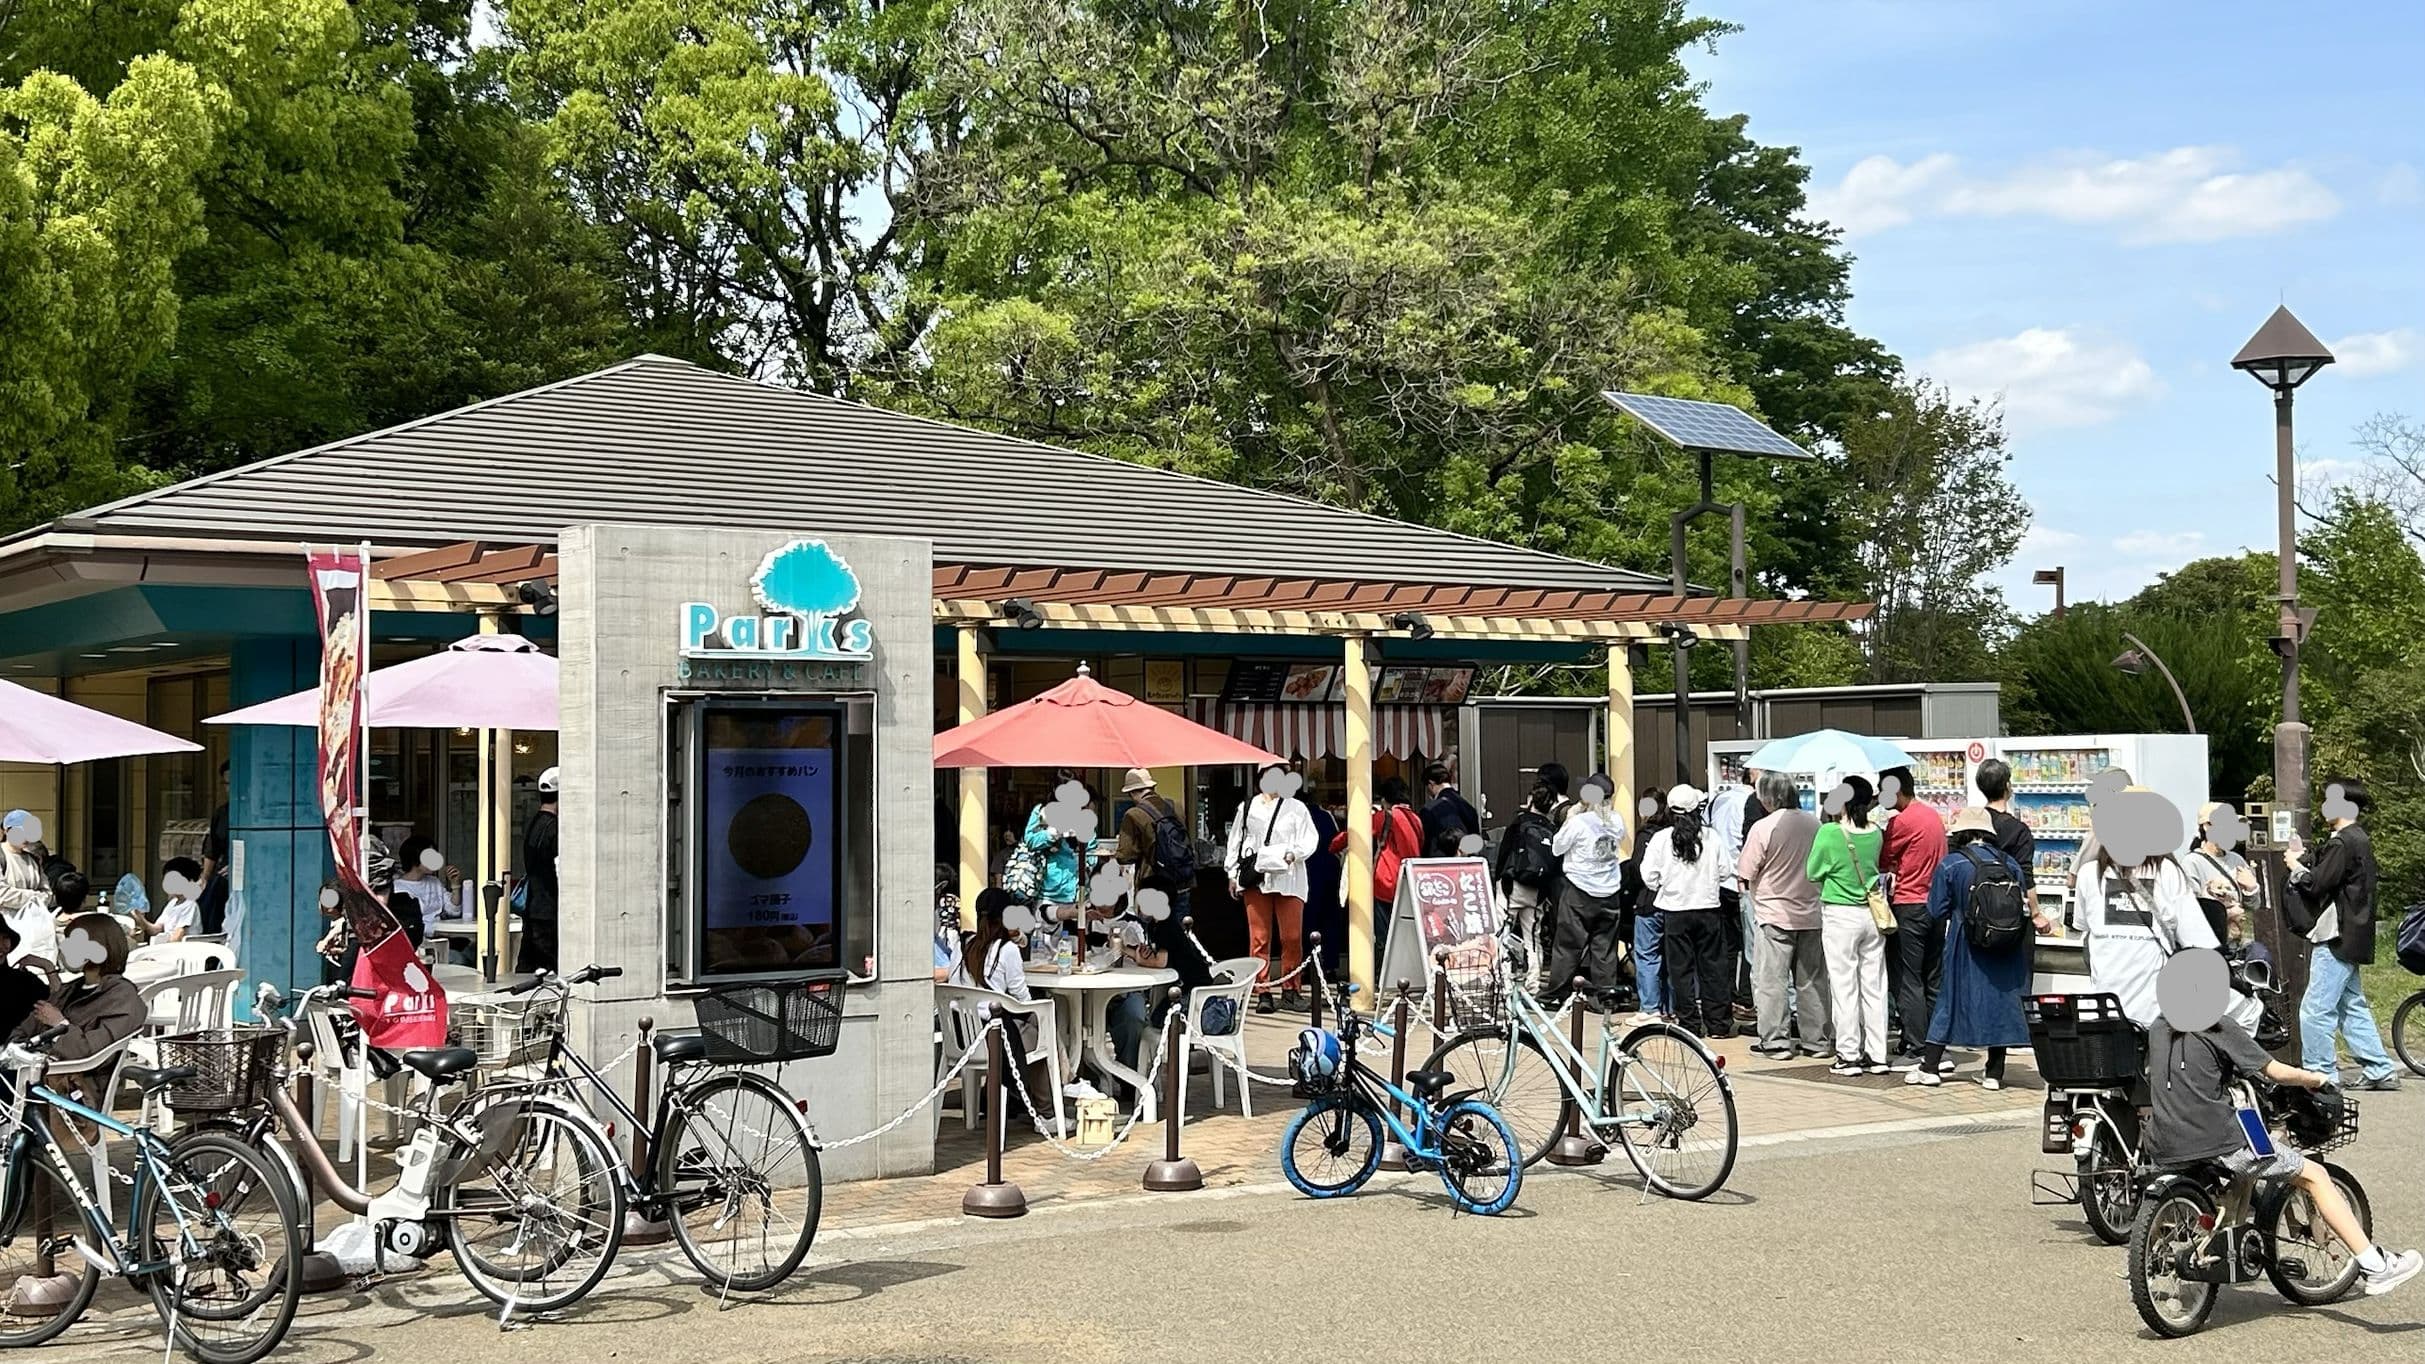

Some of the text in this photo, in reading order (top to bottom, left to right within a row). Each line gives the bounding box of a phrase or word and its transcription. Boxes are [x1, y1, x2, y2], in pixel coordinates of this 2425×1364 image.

[678, 661, 773, 680] BAKERY
[782, 664, 795, 680] &
[45, 1143, 94, 1210] GIANT
